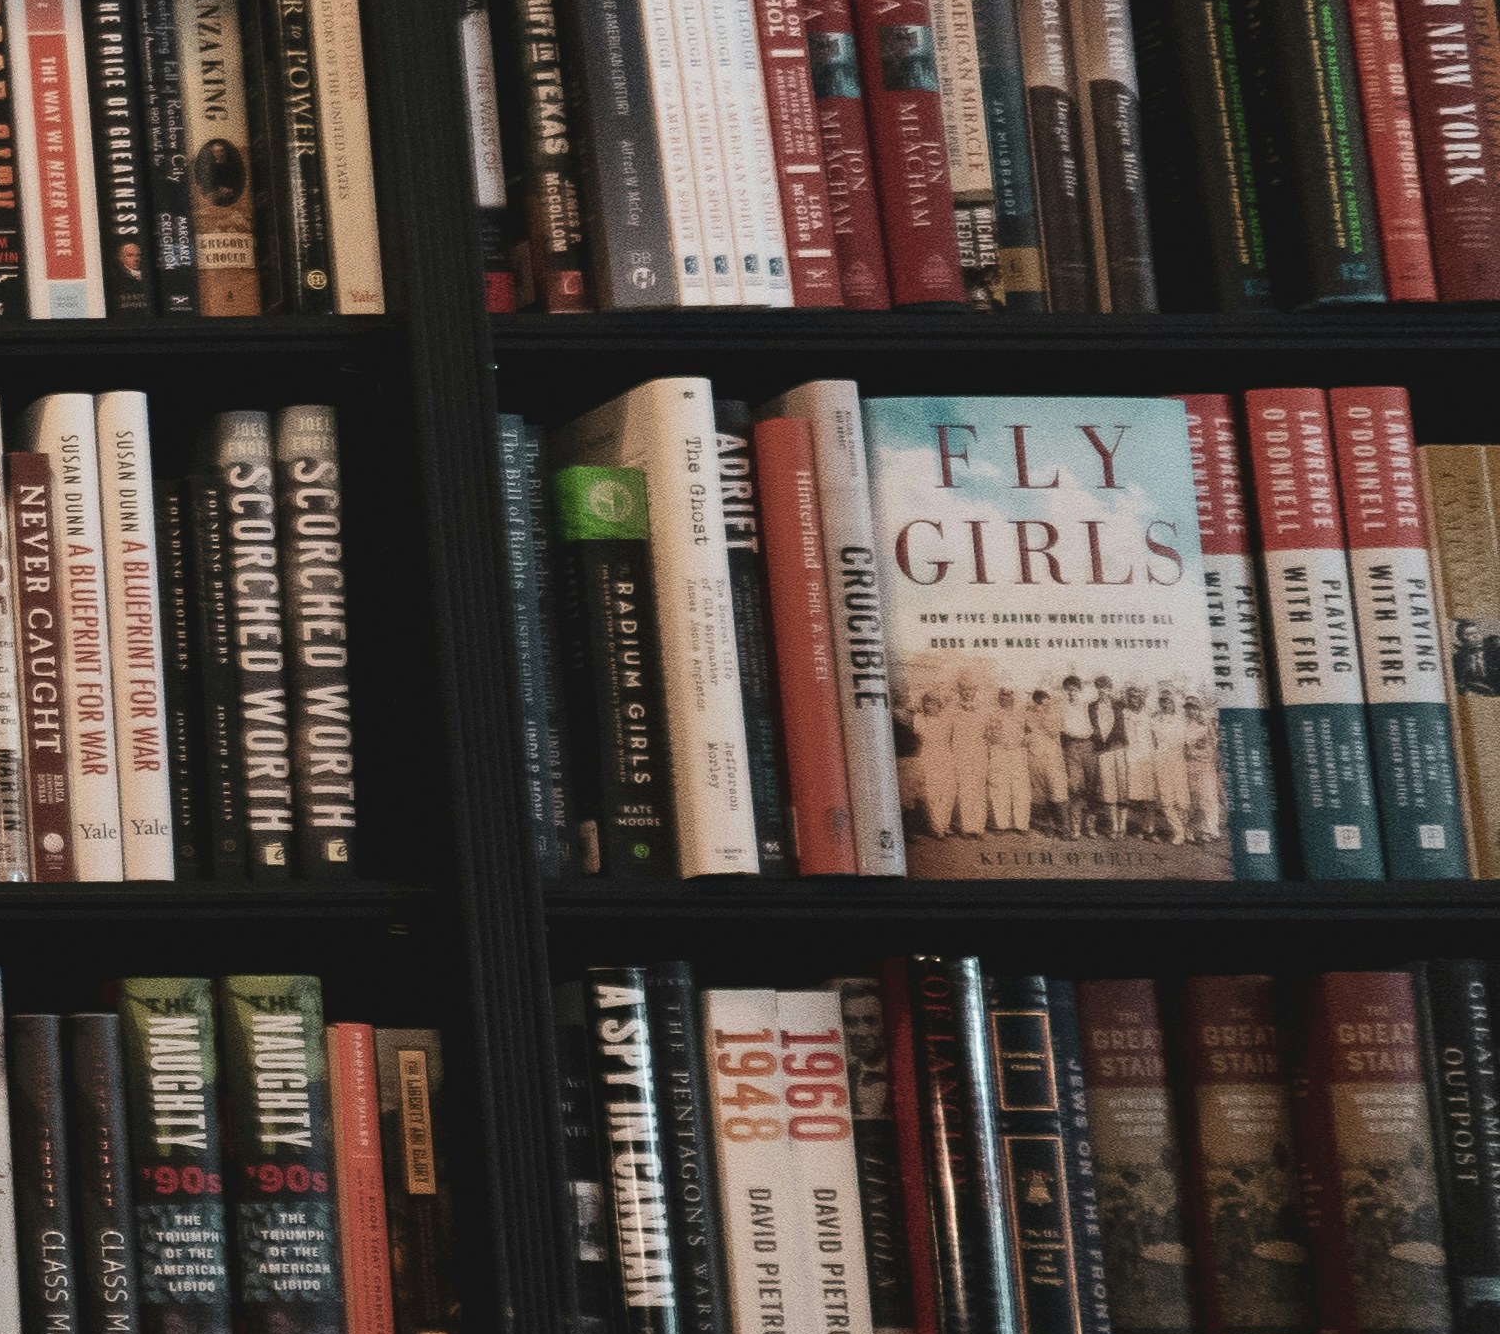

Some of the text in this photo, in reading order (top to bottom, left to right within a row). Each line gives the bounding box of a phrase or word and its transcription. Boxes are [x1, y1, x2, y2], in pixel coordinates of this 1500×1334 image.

[1424, 21, 1470, 88] NEW
[1441, 102, 1485, 185] YORK
[929, 422, 1133, 491] FLY
[894, 516, 1186, 587] GIRLS
[293, 458, 357, 829] SCORCHED WORTH
[253, 1014, 313, 1150] NAUGHTY
[713, 1028, 776, 1144] 1948
[783, 1028, 849, 1144] 1960
[246, 1165, 329, 1195] '90s
